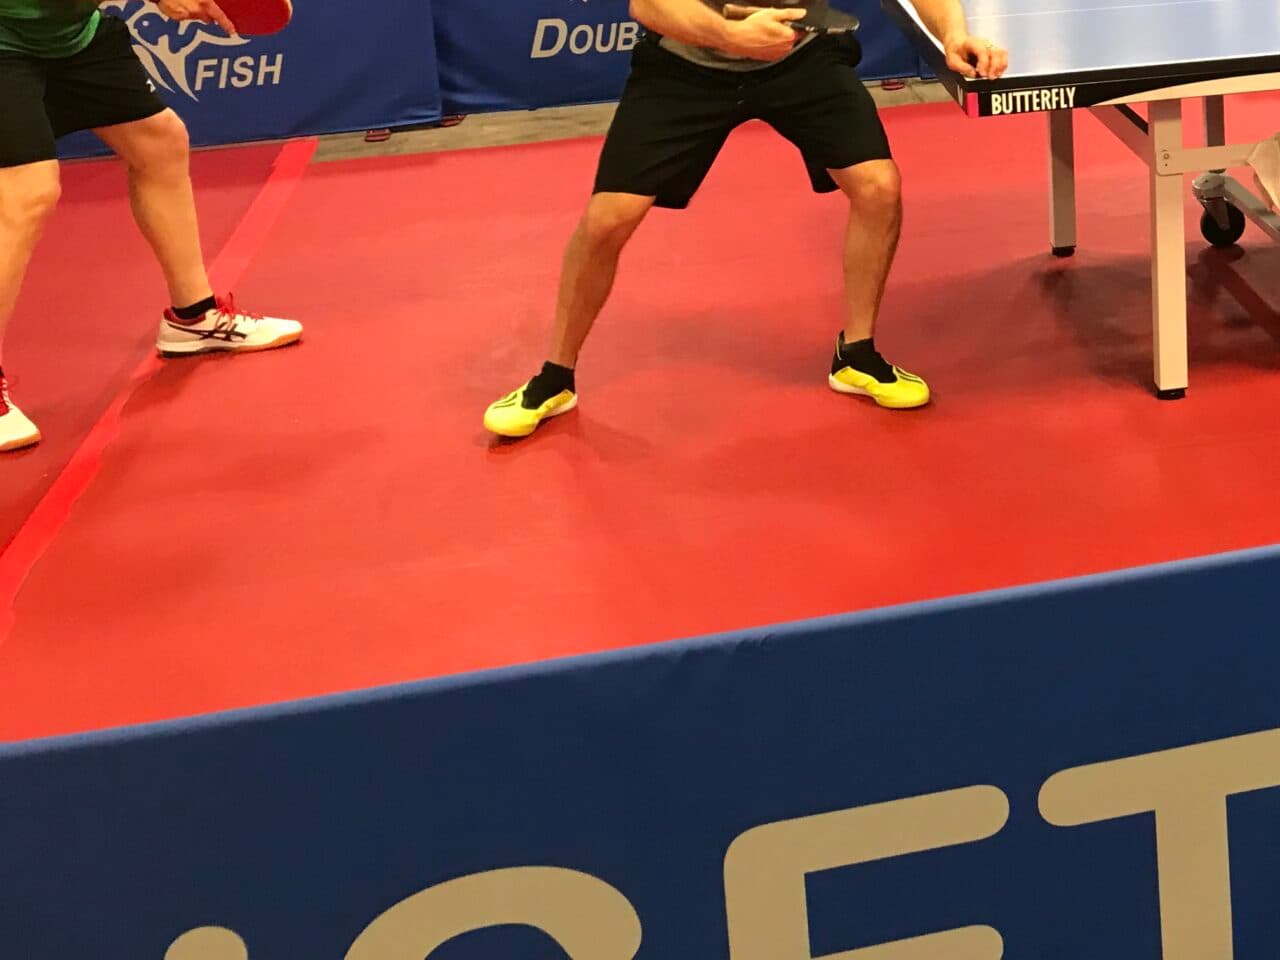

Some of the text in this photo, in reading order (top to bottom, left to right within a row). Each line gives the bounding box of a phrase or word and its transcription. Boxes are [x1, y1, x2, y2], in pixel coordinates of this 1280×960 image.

[530, 18, 640, 59] DOUB
[194, 53, 284, 91] FISH
[991, 86, 1077, 116] BUTTERFLY
